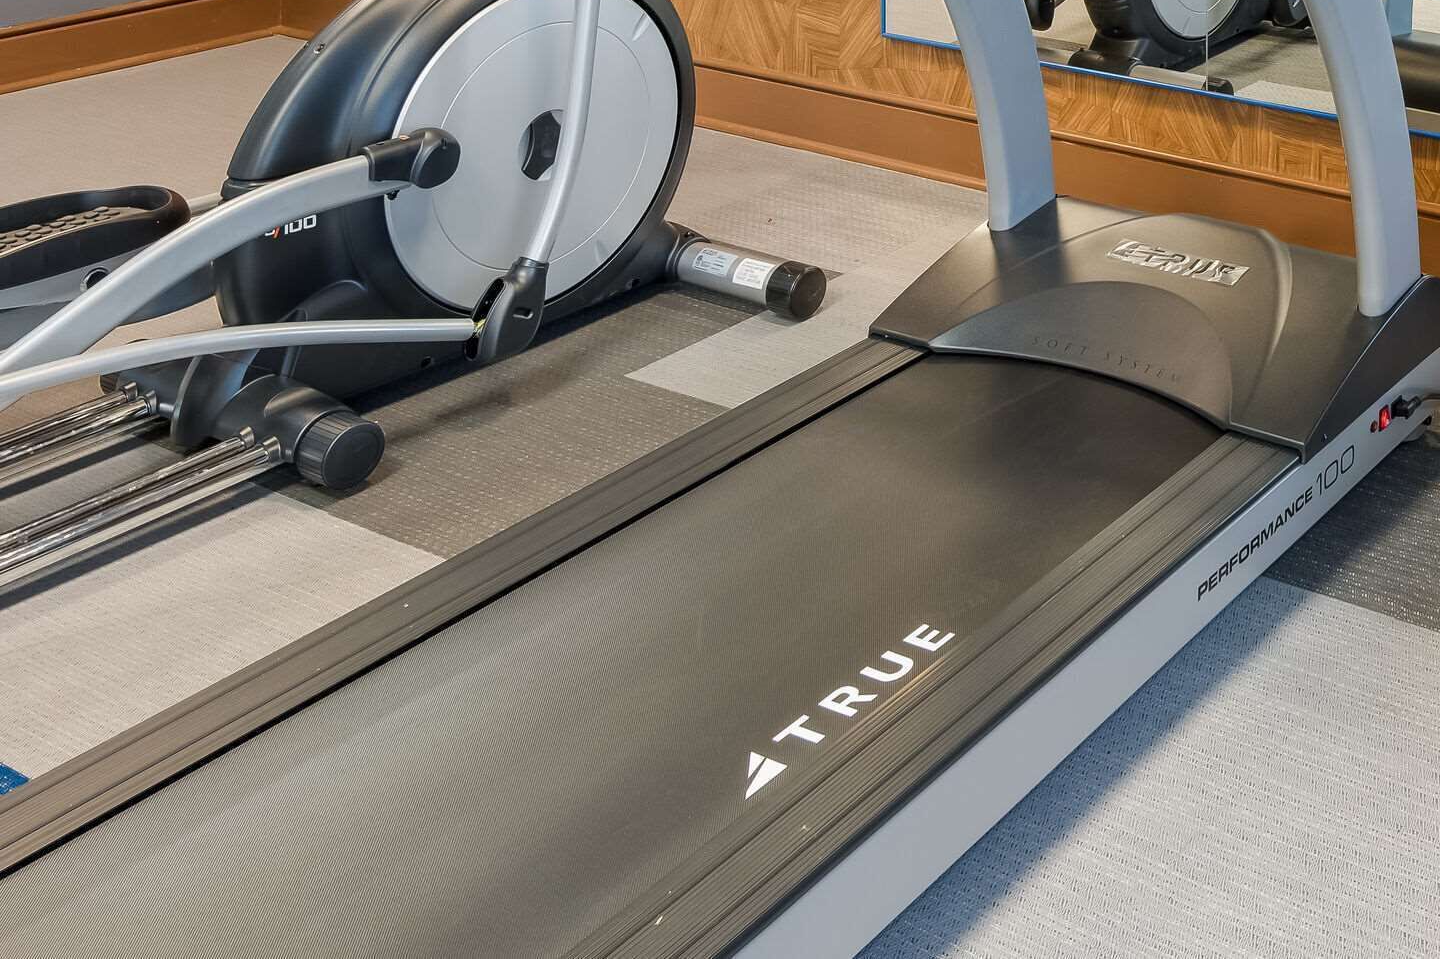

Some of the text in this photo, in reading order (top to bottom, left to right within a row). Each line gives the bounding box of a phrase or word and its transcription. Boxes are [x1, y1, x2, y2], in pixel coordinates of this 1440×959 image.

[1197, 444, 1355, 602] PERFORMANCE 100
[772, 623, 956, 744] TRUE
